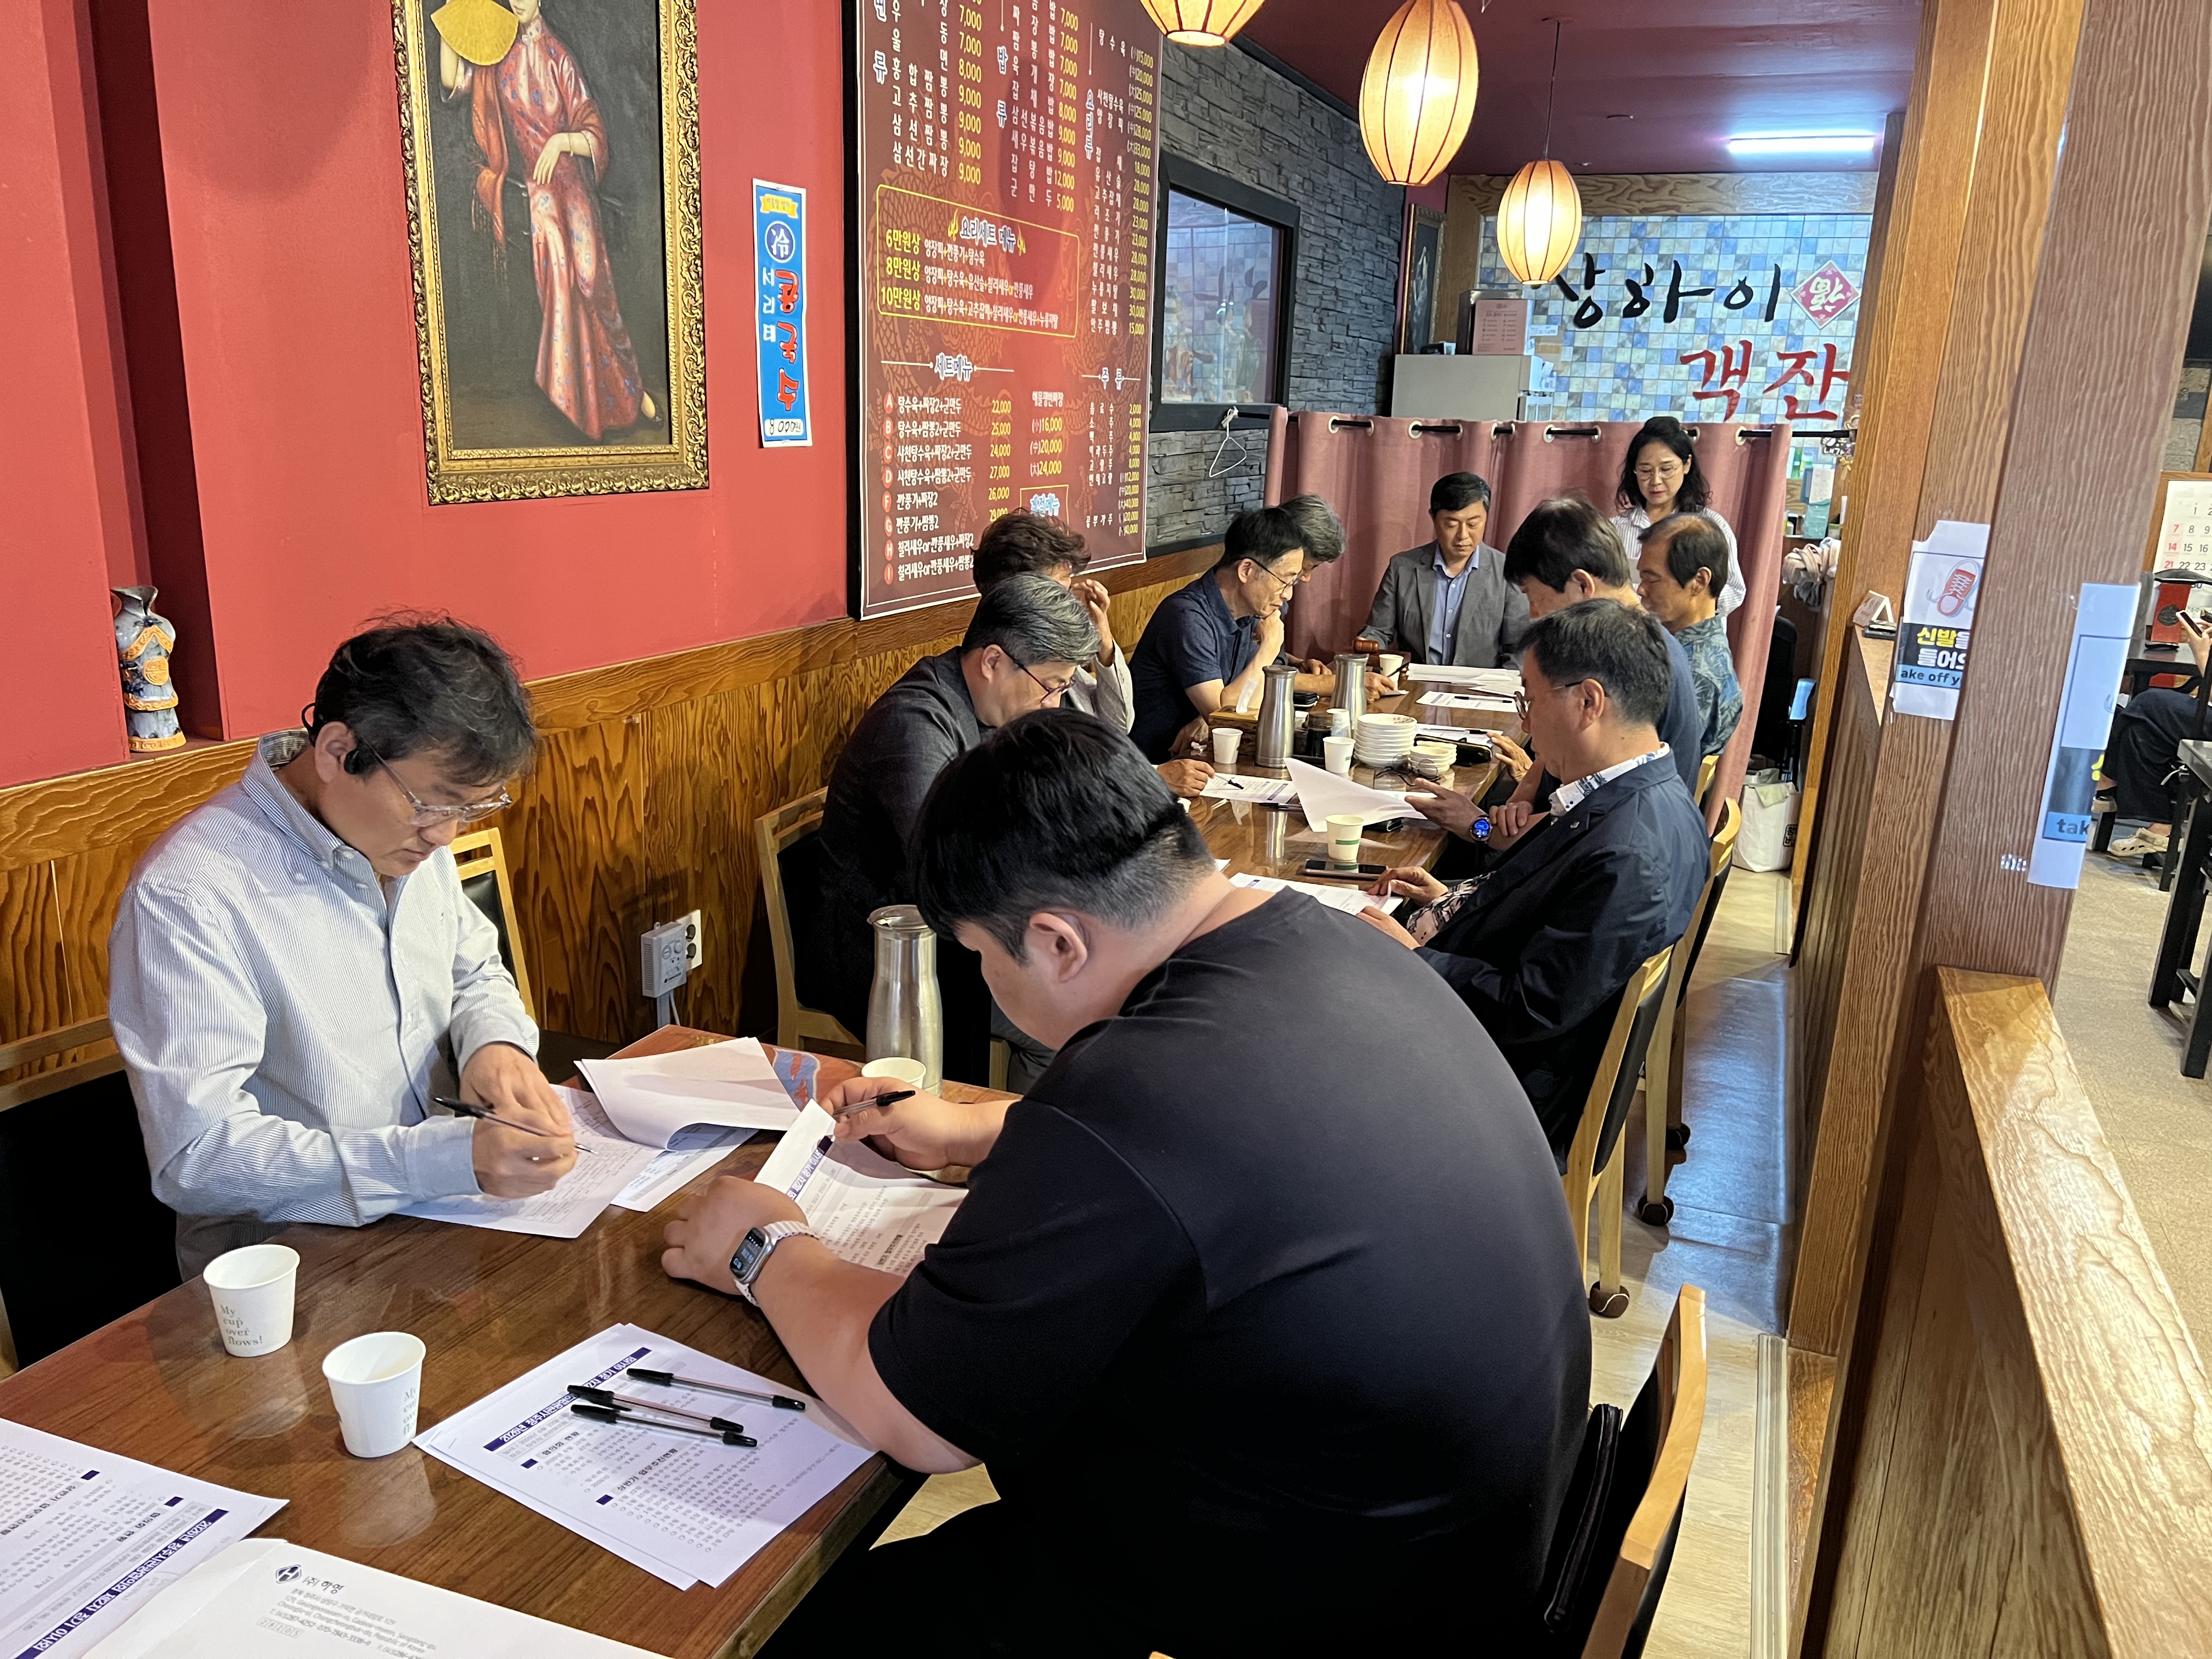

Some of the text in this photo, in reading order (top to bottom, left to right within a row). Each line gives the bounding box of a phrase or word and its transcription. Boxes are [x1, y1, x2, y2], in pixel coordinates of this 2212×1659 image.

[1060, 8, 1079, 31] 7,000
[959, 31, 981, 57] 7,000
[1060, 32, 1078, 54] 7,000
[959, 59, 981, 83] 8,000
[1060, 55, 1077, 77] 7,000
[959, 84, 981, 109] 9,000
[1059, 78, 1076, 100] 7,000
[959, 111, 981, 134] 9,000
[1058, 102, 1076, 123] 8,000
[1058, 125, 1076, 145] 9,000
[959, 137, 981, 160] 9,000
[1058, 148, 1075, 168] 9,000
[959, 162, 981, 185] 9,000
[1054, 170, 1075, 190] 12,000
[1057, 193, 1074, 212] 5,000
[771, 228, 790, 258] 冷
[886, 229, 921, 255] 6만원상
[960, 216, 1015, 253] 요리세트 메뉴
[886, 256, 921, 281] 8만원상
[881, 286, 921, 311] 10만원상
[774, 269, 799, 411] 콩국수
[934, 352, 973, 382] 세트메뉴
[1680, 340, 1849, 422] 객잔
[992, 400, 1012, 414] 22,000
[991, 422, 1011, 437] 25,000
[990, 444, 1011, 458] 24,000
[989, 465, 1009, 480] 27,000
[989, 487, 1009, 501] 26,000
[2188, 525, 2194, 533] 8
[2204, 526, 2210, 534] 9
[2168, 543, 2208, 552] 14 15 16
[2164, 561, 2206, 571] 21 22 23
[1928, 672, 1949, 682] off
[221, 1305, 236, 1317] My
[223, 1318, 243, 1328] cup
[499, 1424, 528, 1442] 2026년
[179, 1520, 212, 1543] 2026년
[321, 1580, 345, 1594] 하영
[64, 1612, 90, 1628] 정기
[33, 1627, 68, 1651] 이사회
